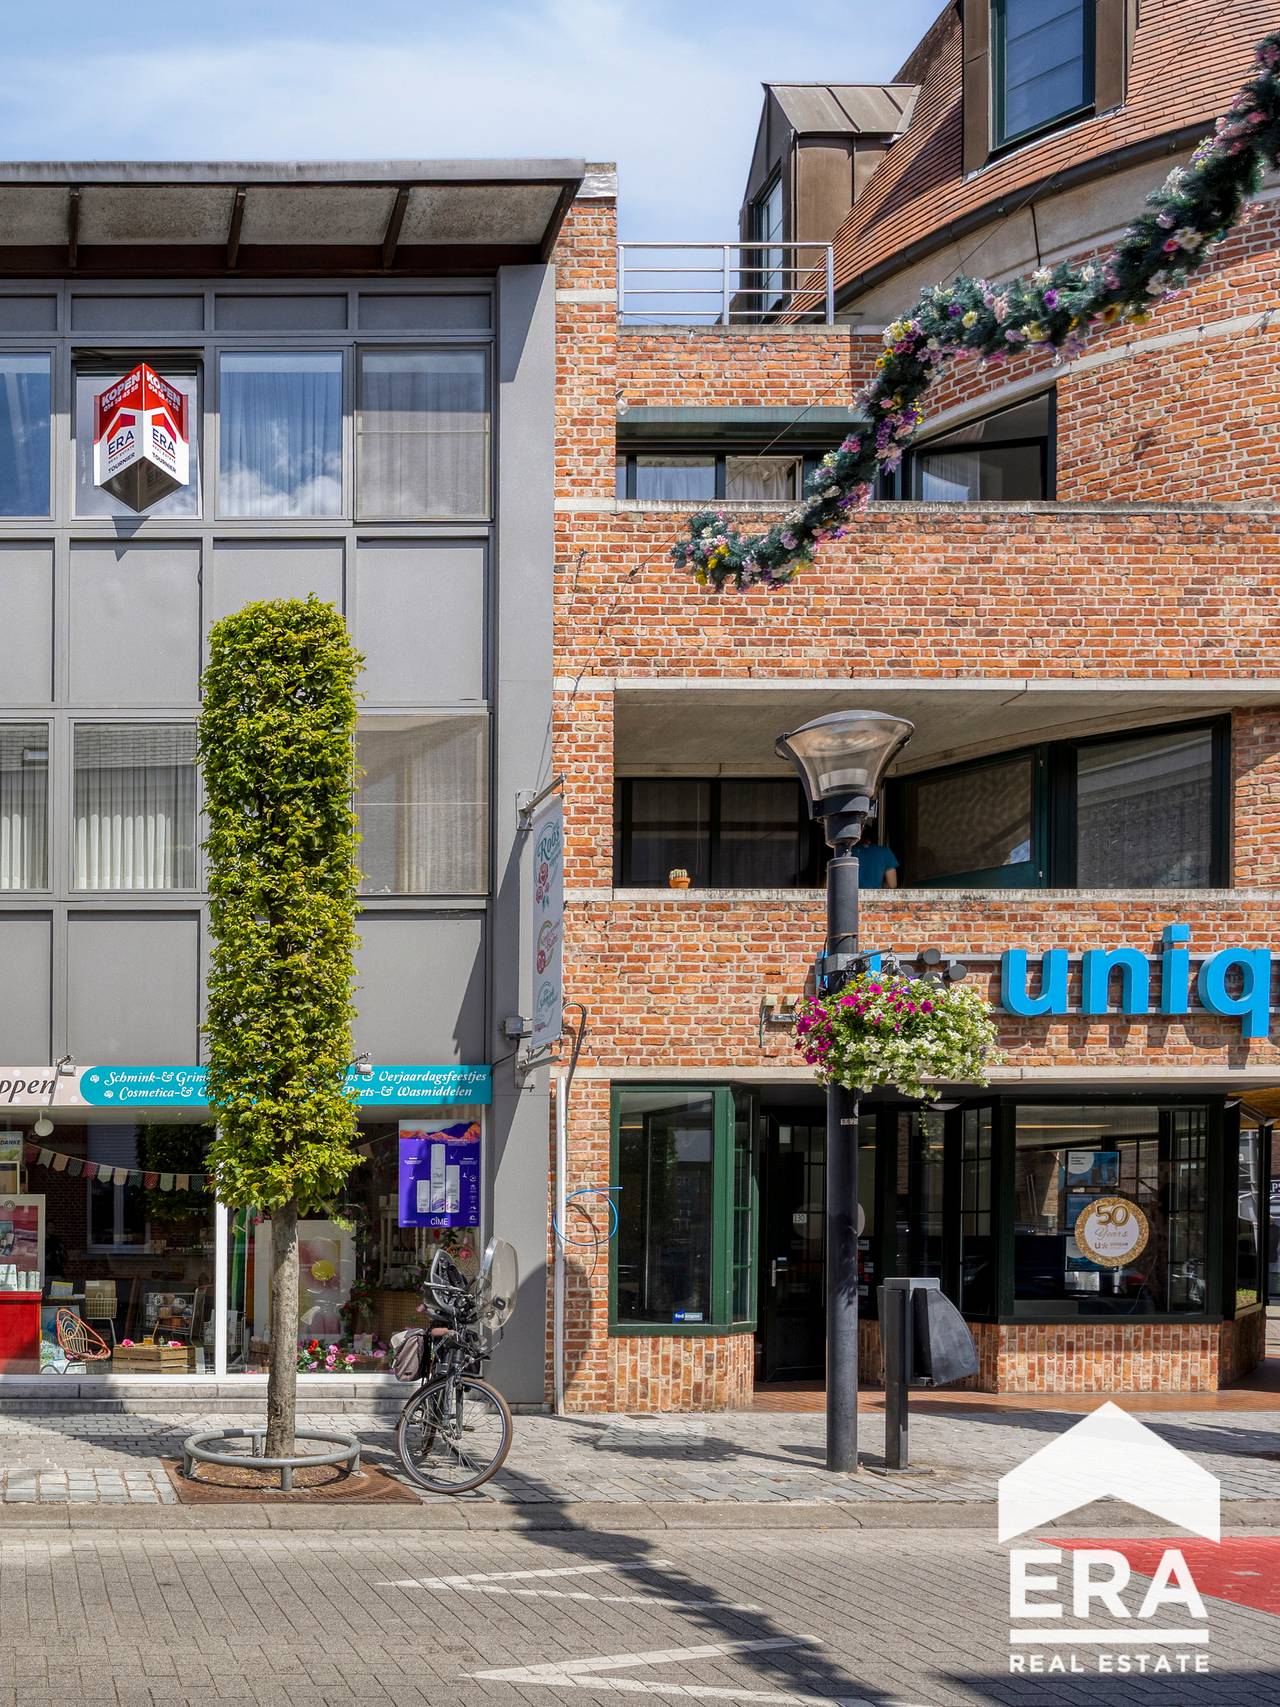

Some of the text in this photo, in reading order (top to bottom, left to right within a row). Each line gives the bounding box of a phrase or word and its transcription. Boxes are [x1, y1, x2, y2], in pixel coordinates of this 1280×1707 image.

[101, 370, 140, 407] KOPEN
[146, 370, 180, 406] KOPEN
[109, 430, 134, 455] ERA
[152, 428, 176, 455] ERA
[108, 452, 136, 473] TOURNIER
[152, 452, 176, 473] TOURNIER
[1001, 924, 1271, 1038] uniq
[379, 1070, 486, 1086] Verjaardagsfeestjes
[397, 1086, 472, 1097] Wasmiddelen
[794, 1214, 806, 1222] 130
[1095, 1202, 1128, 1227] 50
